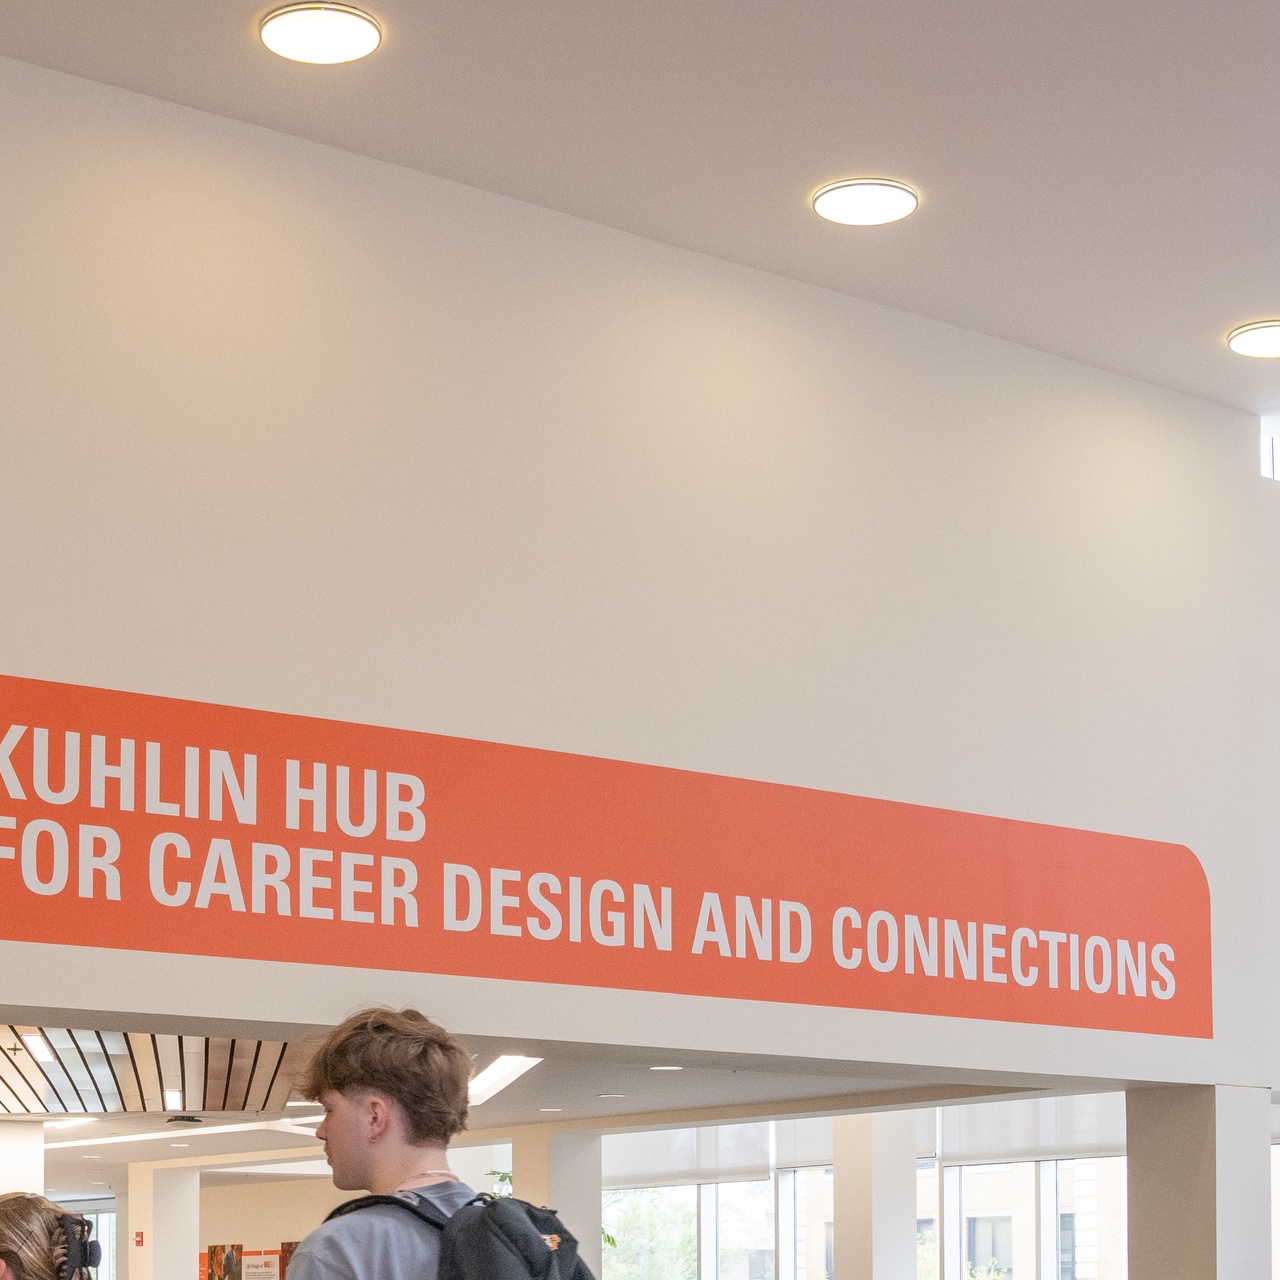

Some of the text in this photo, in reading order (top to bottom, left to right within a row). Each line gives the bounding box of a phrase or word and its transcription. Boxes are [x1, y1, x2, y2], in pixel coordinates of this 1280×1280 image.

[285, 758, 426, 843] HUB
[149, 832, 419, 928] CAREER
[443, 862, 672, 952] DESIGN
[691, 891, 812, 964] AND
[832, 906, 1176, 1000] CONNECTIONS
